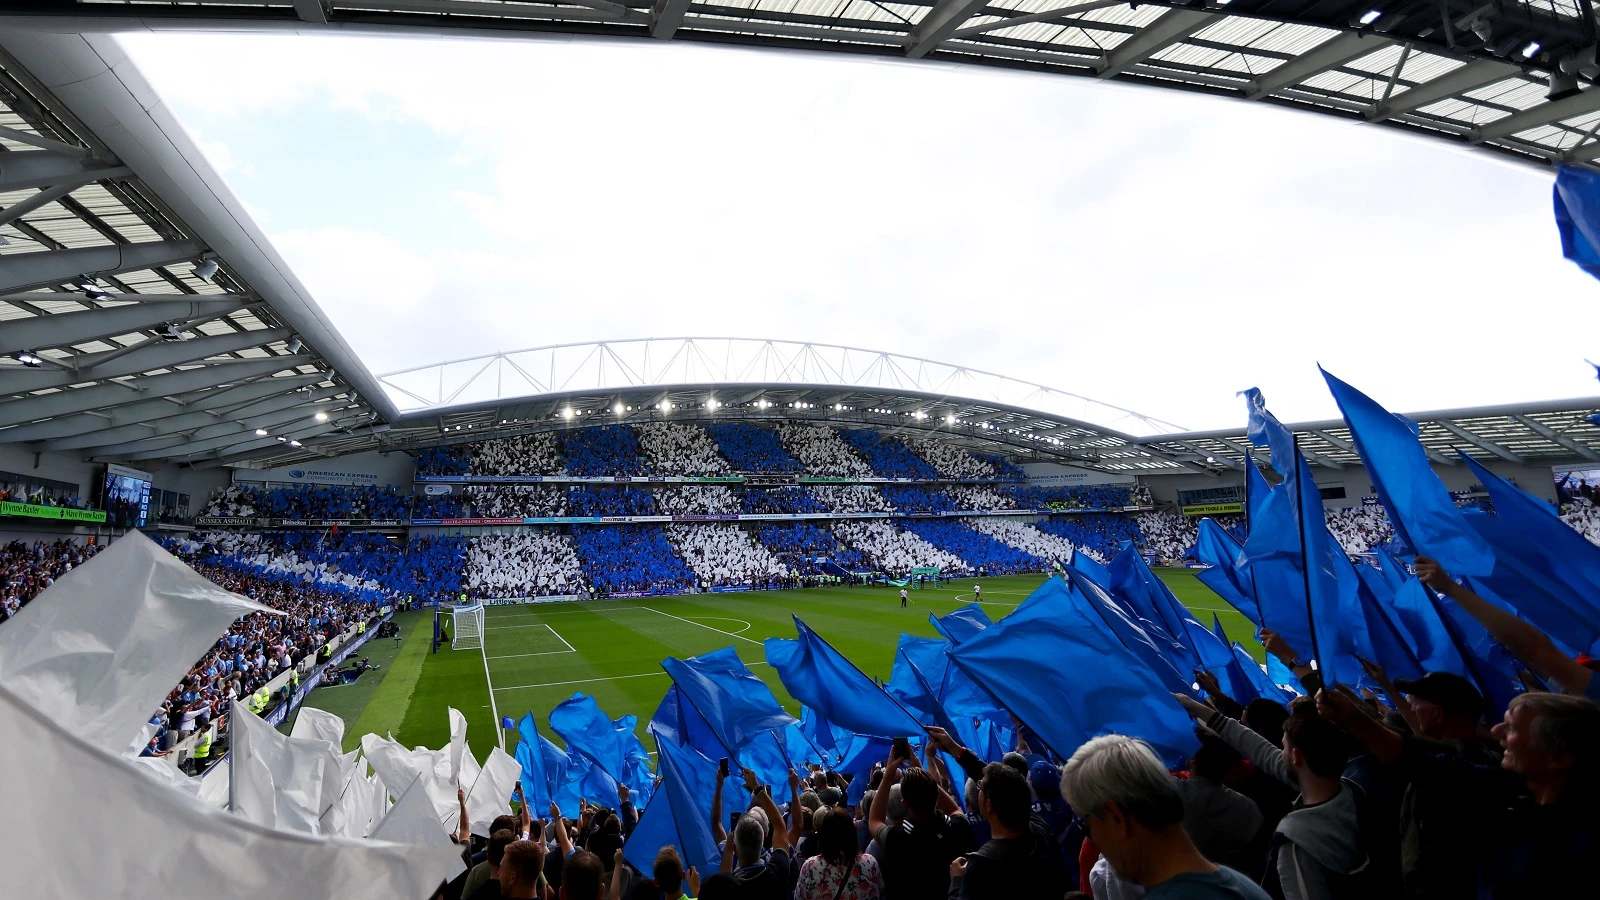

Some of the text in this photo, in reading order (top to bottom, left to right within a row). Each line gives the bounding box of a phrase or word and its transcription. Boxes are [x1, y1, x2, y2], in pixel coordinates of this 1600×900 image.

[2, 502, 22, 513] Wynne
[22, 505, 40, 515] Baxter
[65, 510, 78, 520] Mayo
[79, 511, 92, 519] Wynne
[92, 512, 105, 520] Baxter
